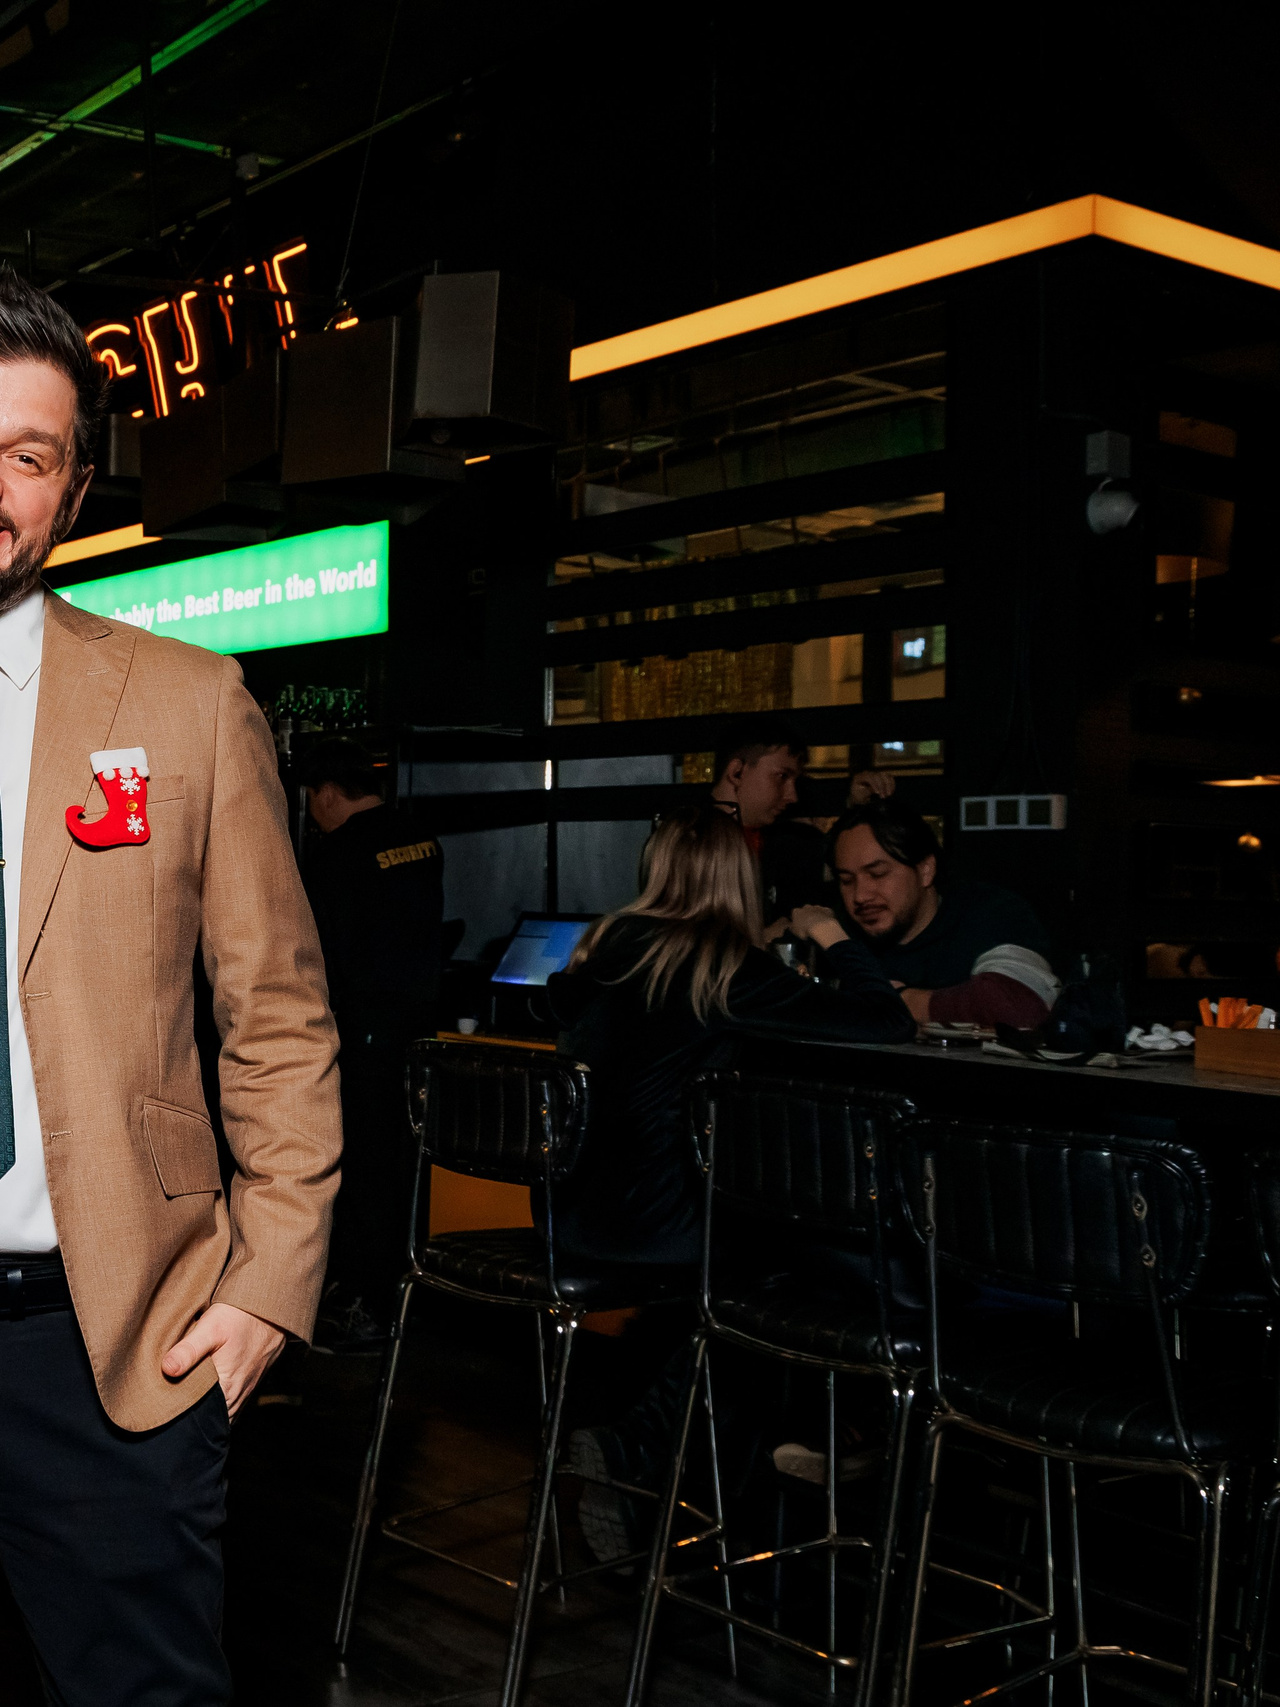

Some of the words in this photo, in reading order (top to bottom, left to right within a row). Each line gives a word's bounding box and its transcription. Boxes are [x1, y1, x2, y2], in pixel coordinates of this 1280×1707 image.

[156, 598, 182, 623] the
[184, 591, 220, 619] Best
[222, 587, 263, 612] Beer
[264, 579, 283, 605] in
[285, 573, 316, 601] the
[319, 559, 378, 595] World
